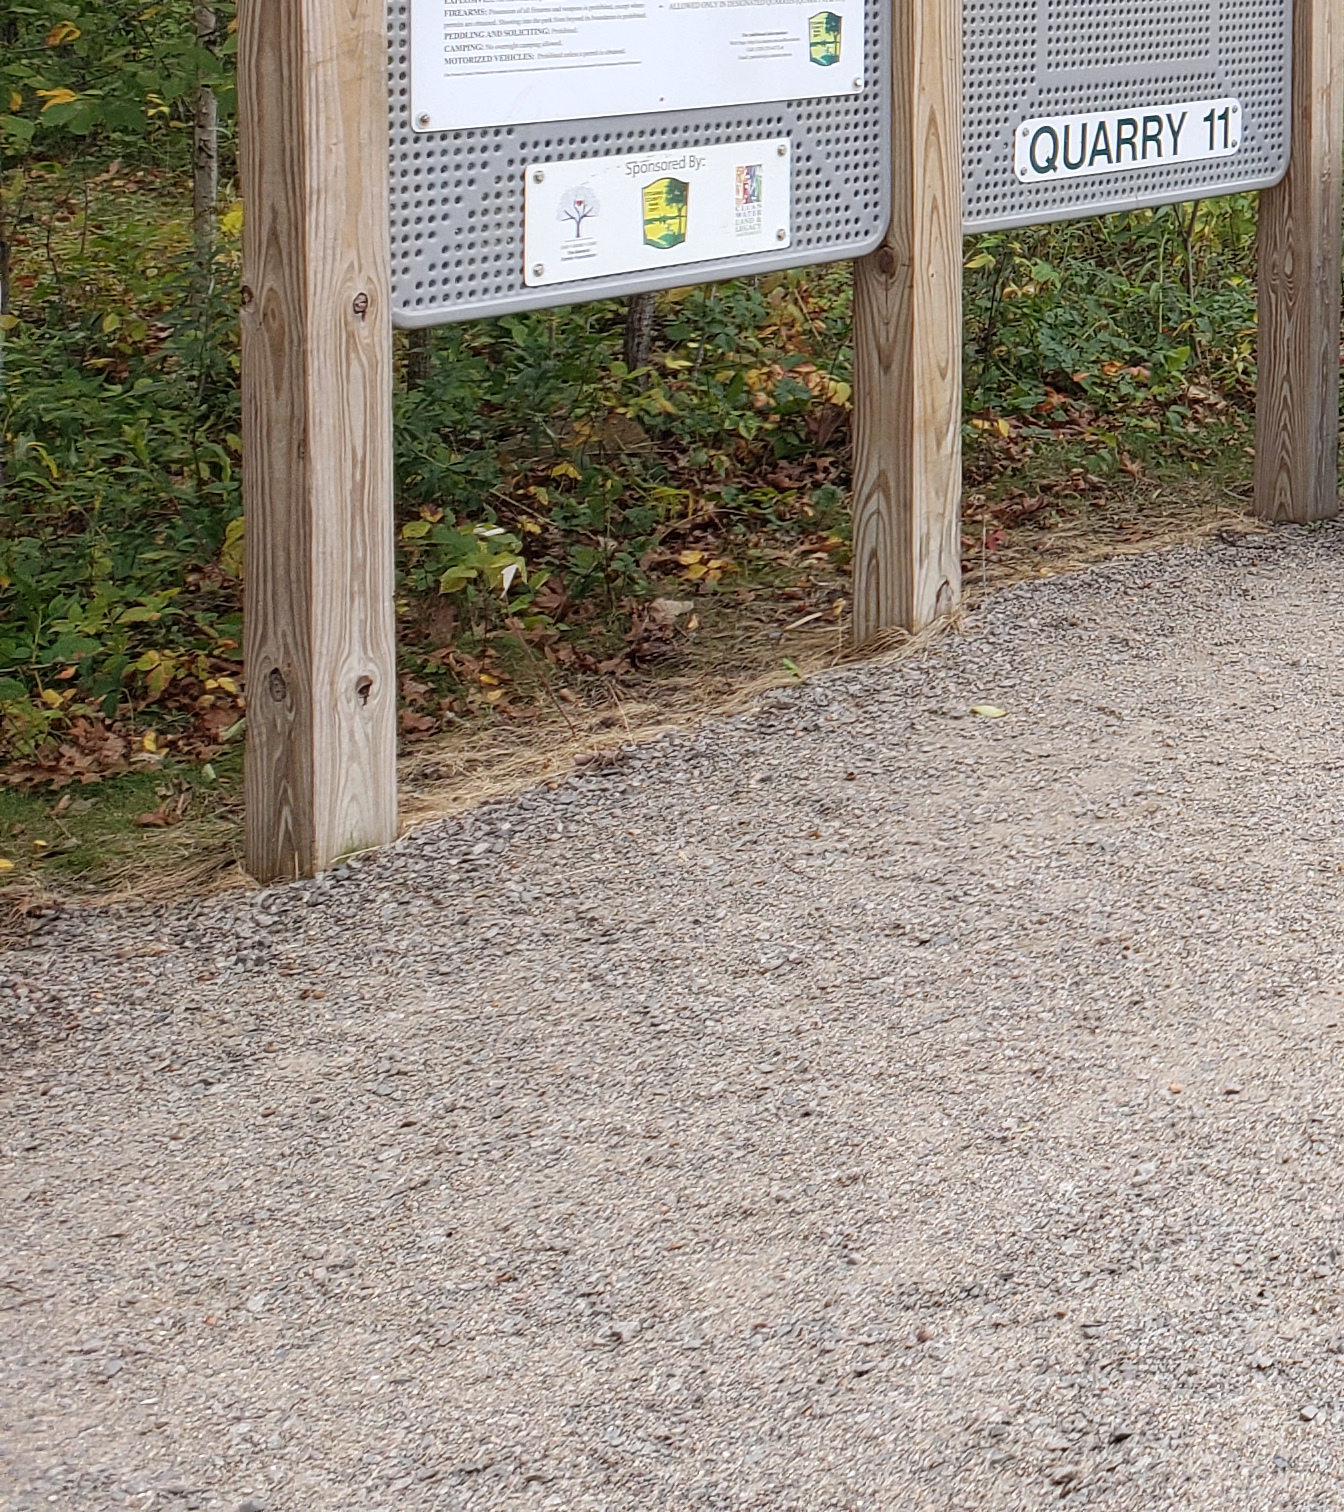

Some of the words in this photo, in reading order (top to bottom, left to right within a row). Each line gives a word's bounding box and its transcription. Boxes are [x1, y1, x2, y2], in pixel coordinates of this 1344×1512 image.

[444, 30, 485, 40] PEDDLING
[486, 30, 503, 39] AND
[444, 55, 492, 65] MOTORIZED
[1029, 111, 1188, 174] QUARRY
[1203, 106, 1231, 151] 11
[625, 155, 686, 178] Sponsored
[688, 155, 706, 171] By:
[735, 203, 762, 212] CLEAN
[735, 209, 762, 218] WATER
[735, 217, 755, 226] LAND
[735, 223, 762, 233] LEGACY
